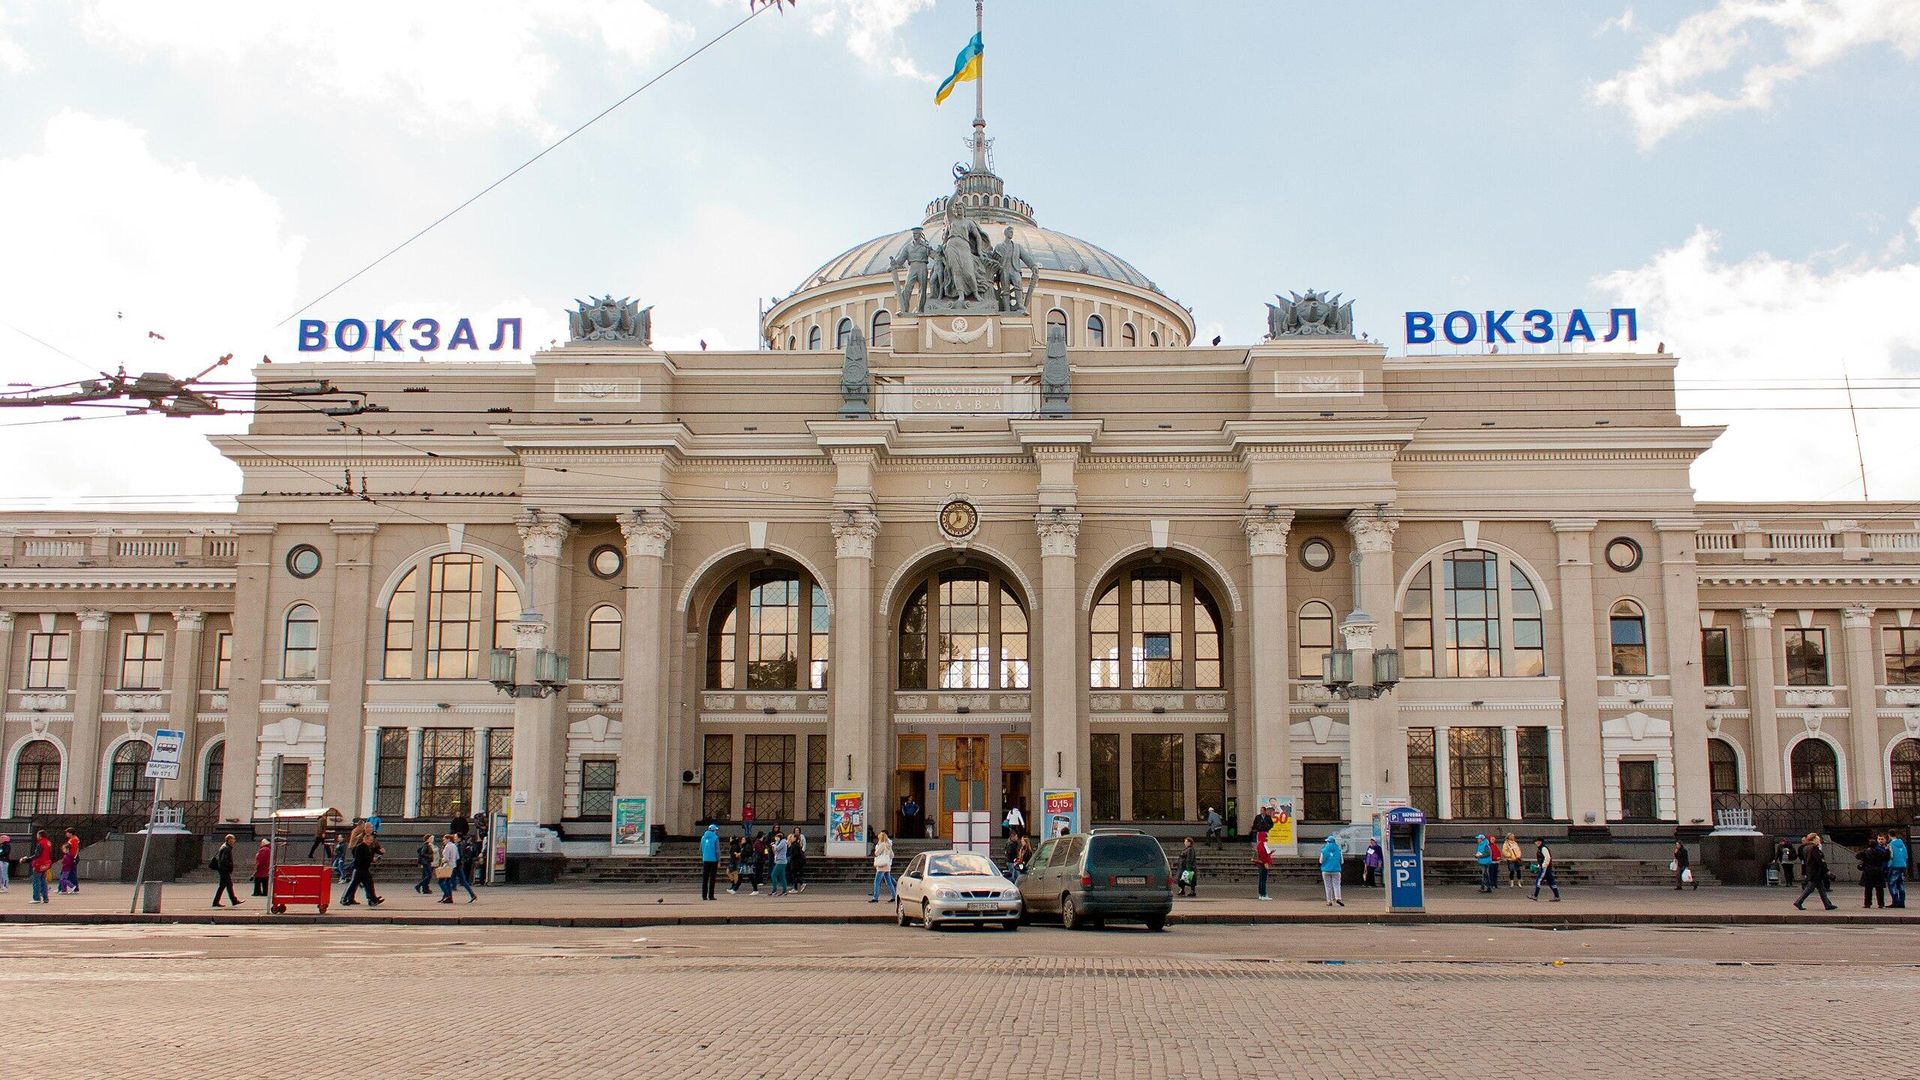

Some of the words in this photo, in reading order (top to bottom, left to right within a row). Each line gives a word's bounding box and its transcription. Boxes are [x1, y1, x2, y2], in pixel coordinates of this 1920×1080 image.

[1405, 308, 1637, 345] ВОКЗАЛ
[299, 318, 522, 351] ВОКЗАЛ
[721, 480, 791, 491] 1905
[926, 479, 989, 490] 1917
[1125, 478, 1192, 488] 1944
[1052, 799, 1069, 809] 0,15
[1396, 869, 1410, 888] P
